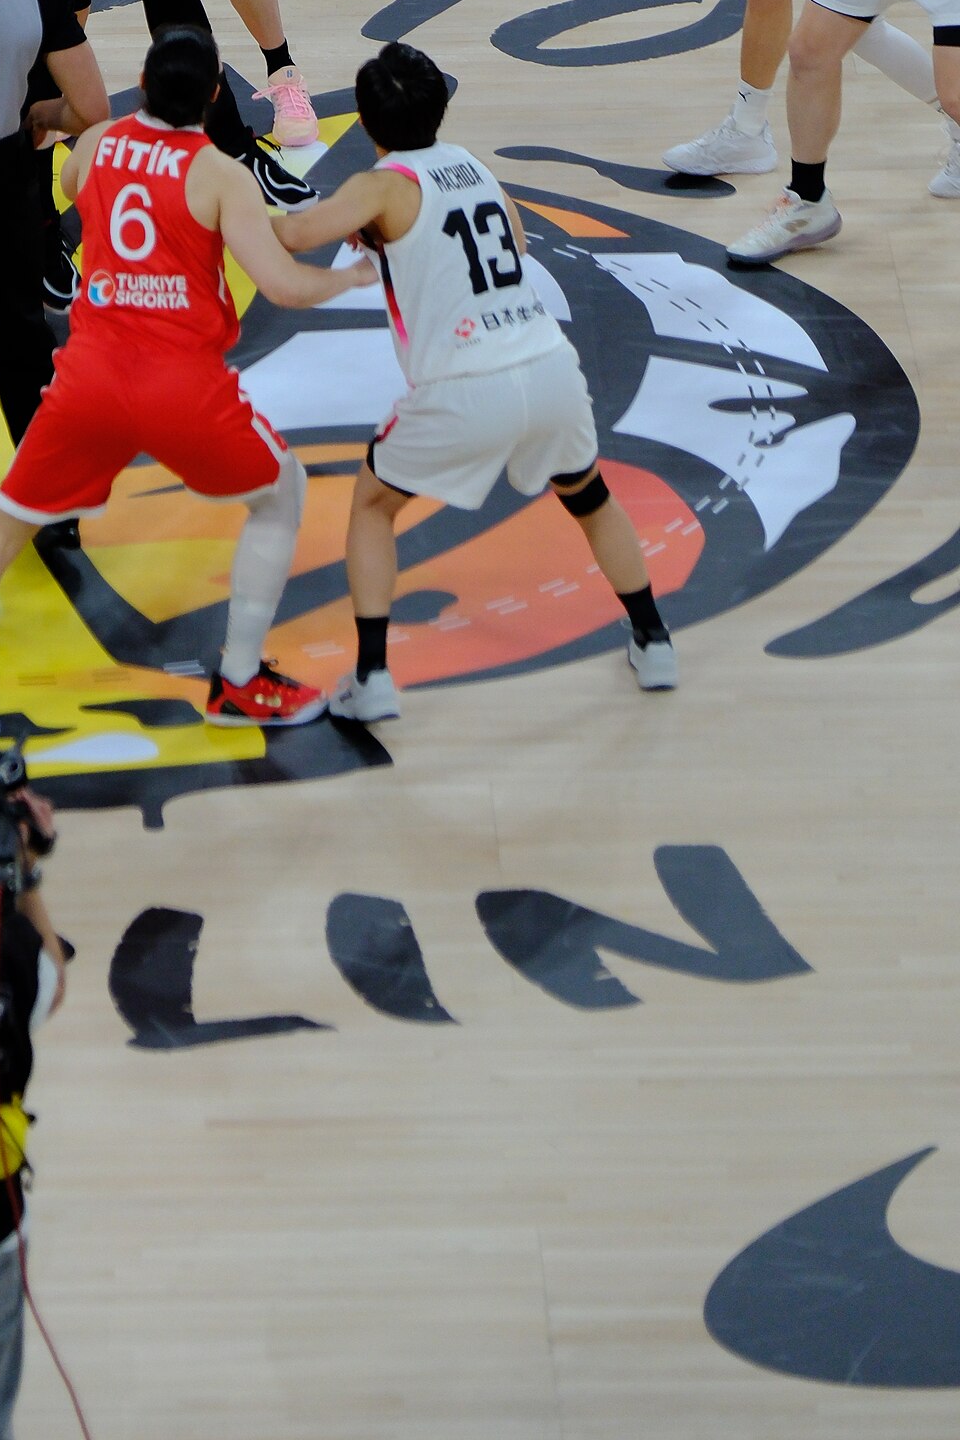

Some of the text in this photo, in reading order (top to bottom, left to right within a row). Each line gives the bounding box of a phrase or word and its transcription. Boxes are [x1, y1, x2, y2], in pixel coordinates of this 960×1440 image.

[95, 135, 190, 179] FİTİK
[427, 162, 485, 193] MACHIDA
[109, 182, 157, 262] 6
[442, 200, 523, 295] 13
